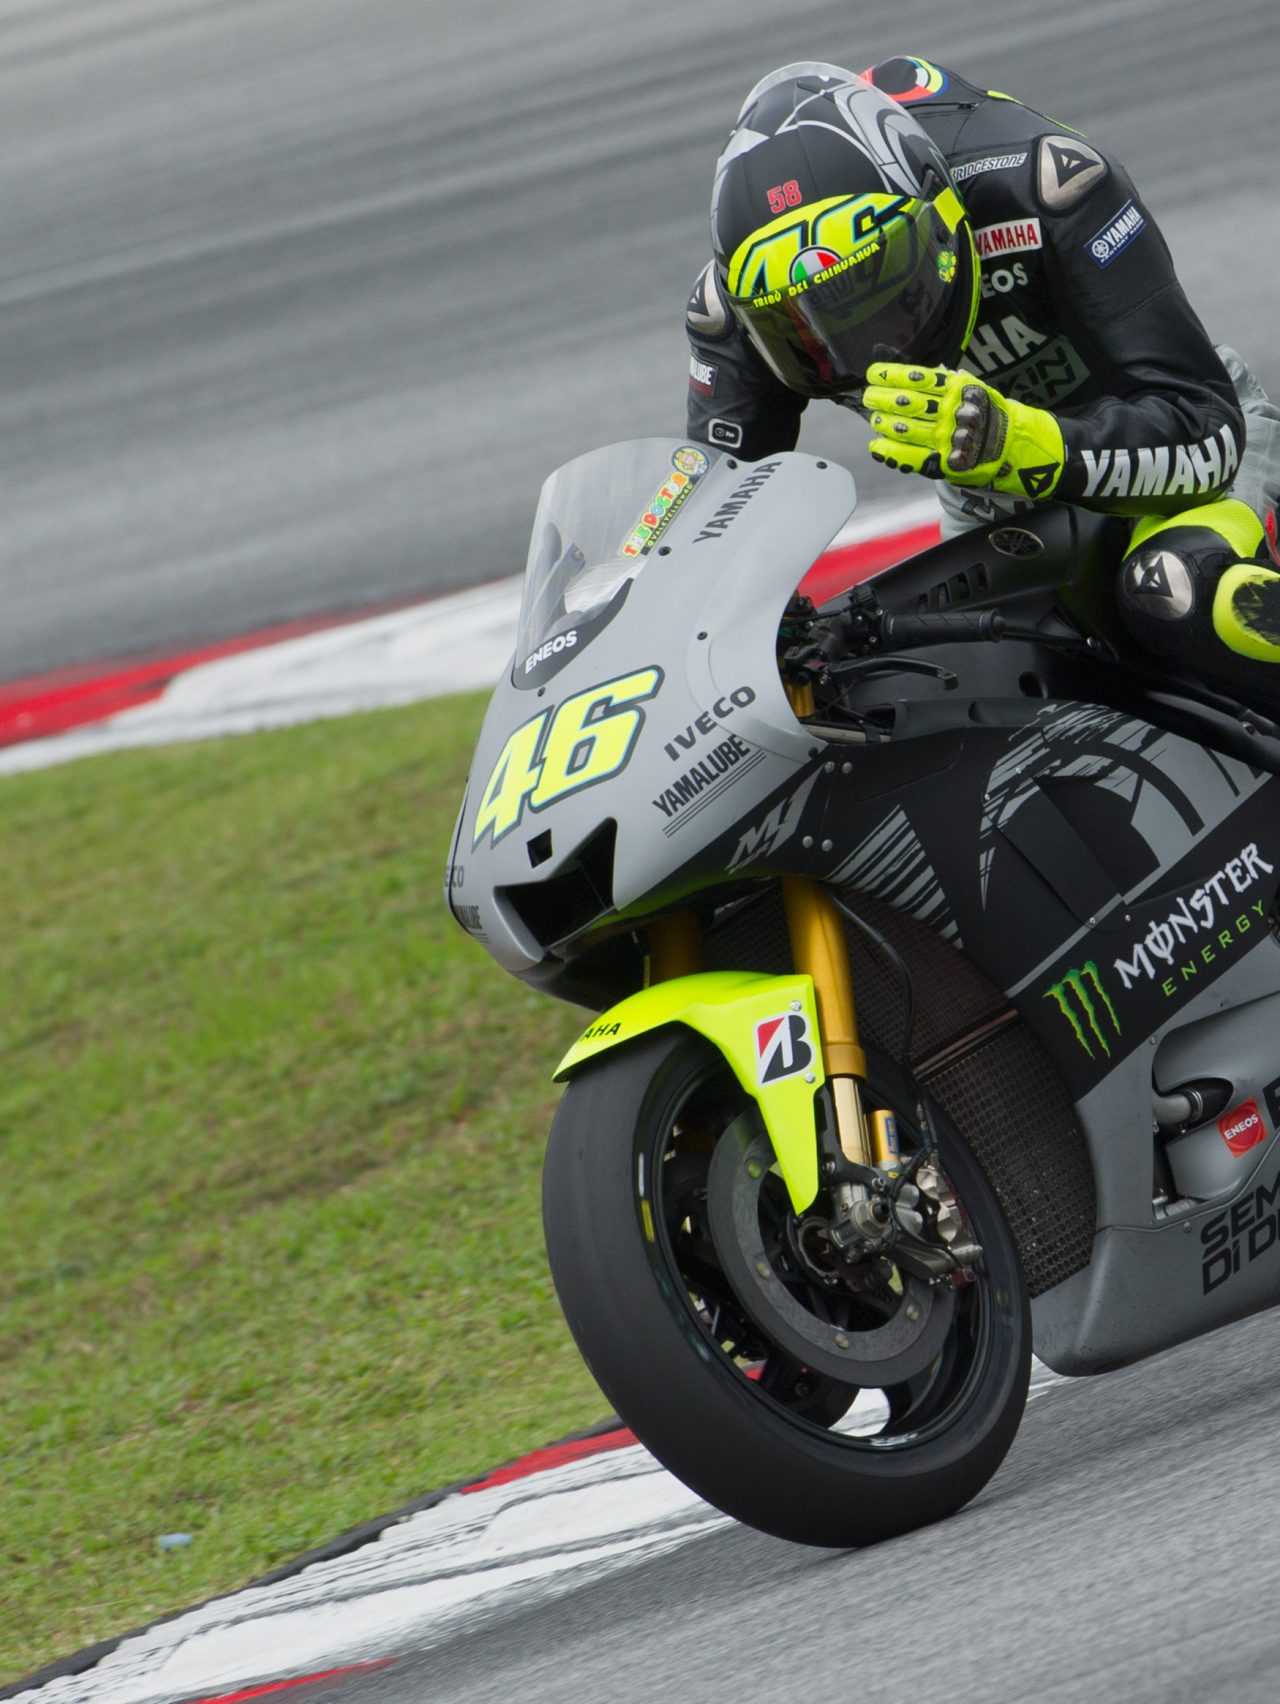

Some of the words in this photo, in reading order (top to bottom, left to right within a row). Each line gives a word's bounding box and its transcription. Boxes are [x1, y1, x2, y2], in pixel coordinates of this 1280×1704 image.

[766, 180, 803, 214] 58
[1102, 206, 1141, 247] YAMAHA
[788, 281, 809, 297] DEI
[813, 242, 881, 284] CHIHUAHUA
[981, 262, 1028, 298] EOS
[1081, 424, 1238, 497] YAMAHA
[623, 524, 652, 558] THE
[643, 472, 689, 528] DOCTOR
[692, 461, 783, 543] YAMAHA
[525, 631, 578, 674] ENEOS
[472, 664, 665, 850] 46
[664, 686, 756, 761] IVECO
[652, 733, 751, 817] YAMALUBE
[1113, 842, 1274, 989] MONSTER
[1162, 900, 1264, 996] ENERGY
[1224, 1113, 1259, 1140] ENEOS
